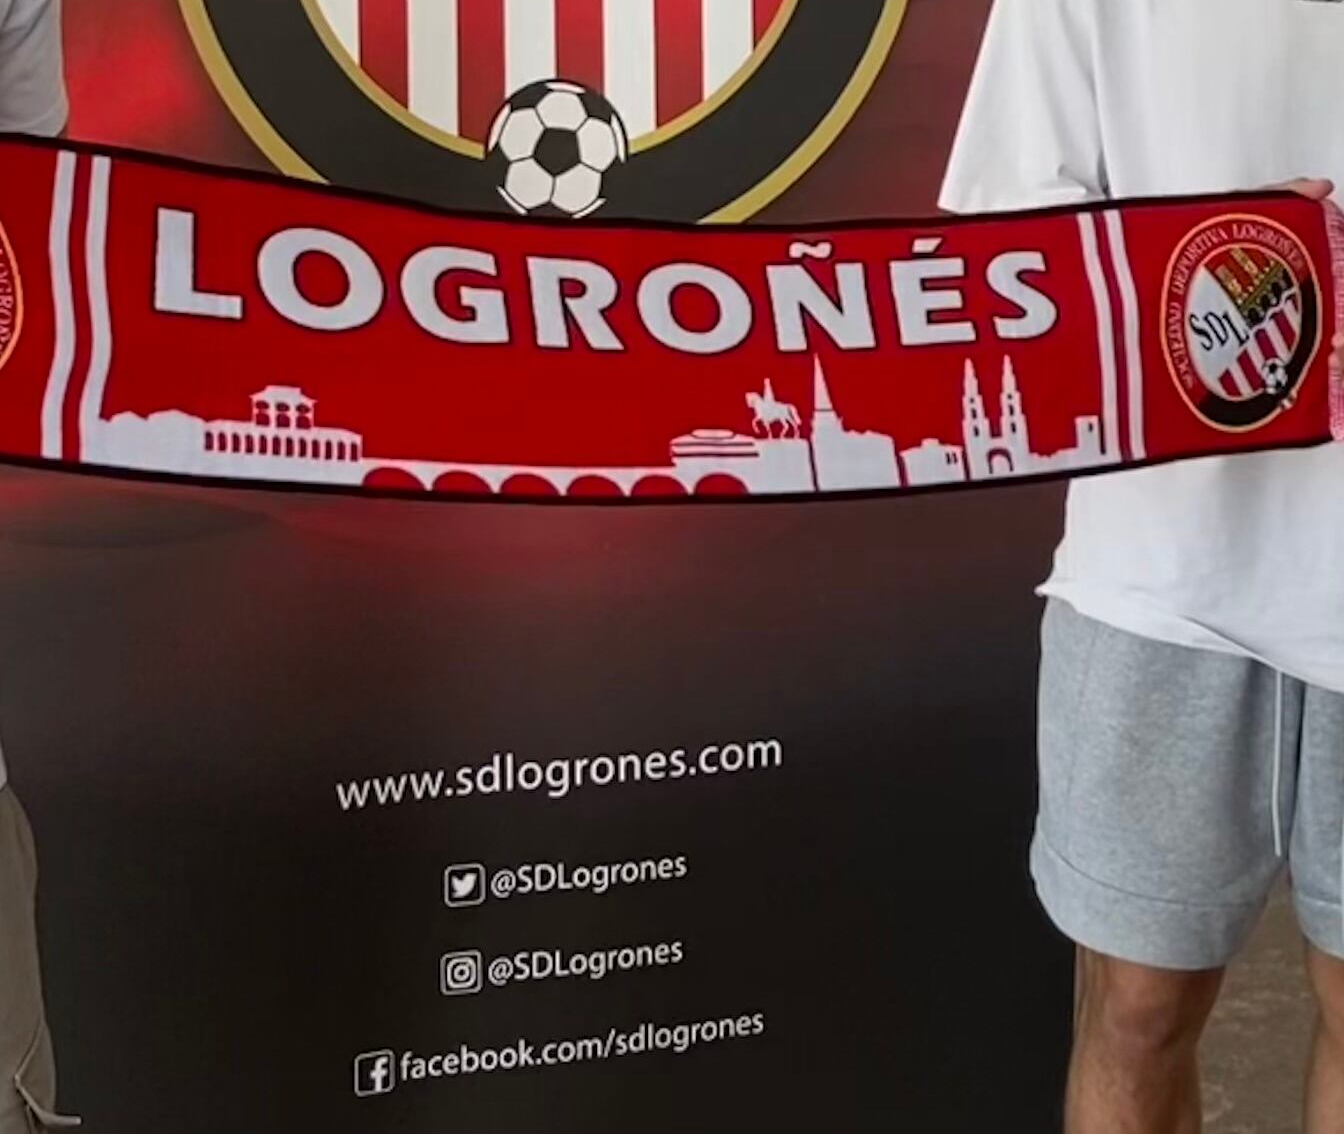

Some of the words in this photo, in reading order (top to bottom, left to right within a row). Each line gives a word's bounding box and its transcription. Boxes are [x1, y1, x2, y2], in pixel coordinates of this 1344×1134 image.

[153, 206, 1059, 355] LOGROÑÉS
[335, 736, 784, 812] www.sdlogrones.com
[489, 854, 688, 899] @SDLogrones
[487, 938, 684, 986] @SDLogrones
[400, 1010, 765, 1082] facebook.com/sdlogrones
